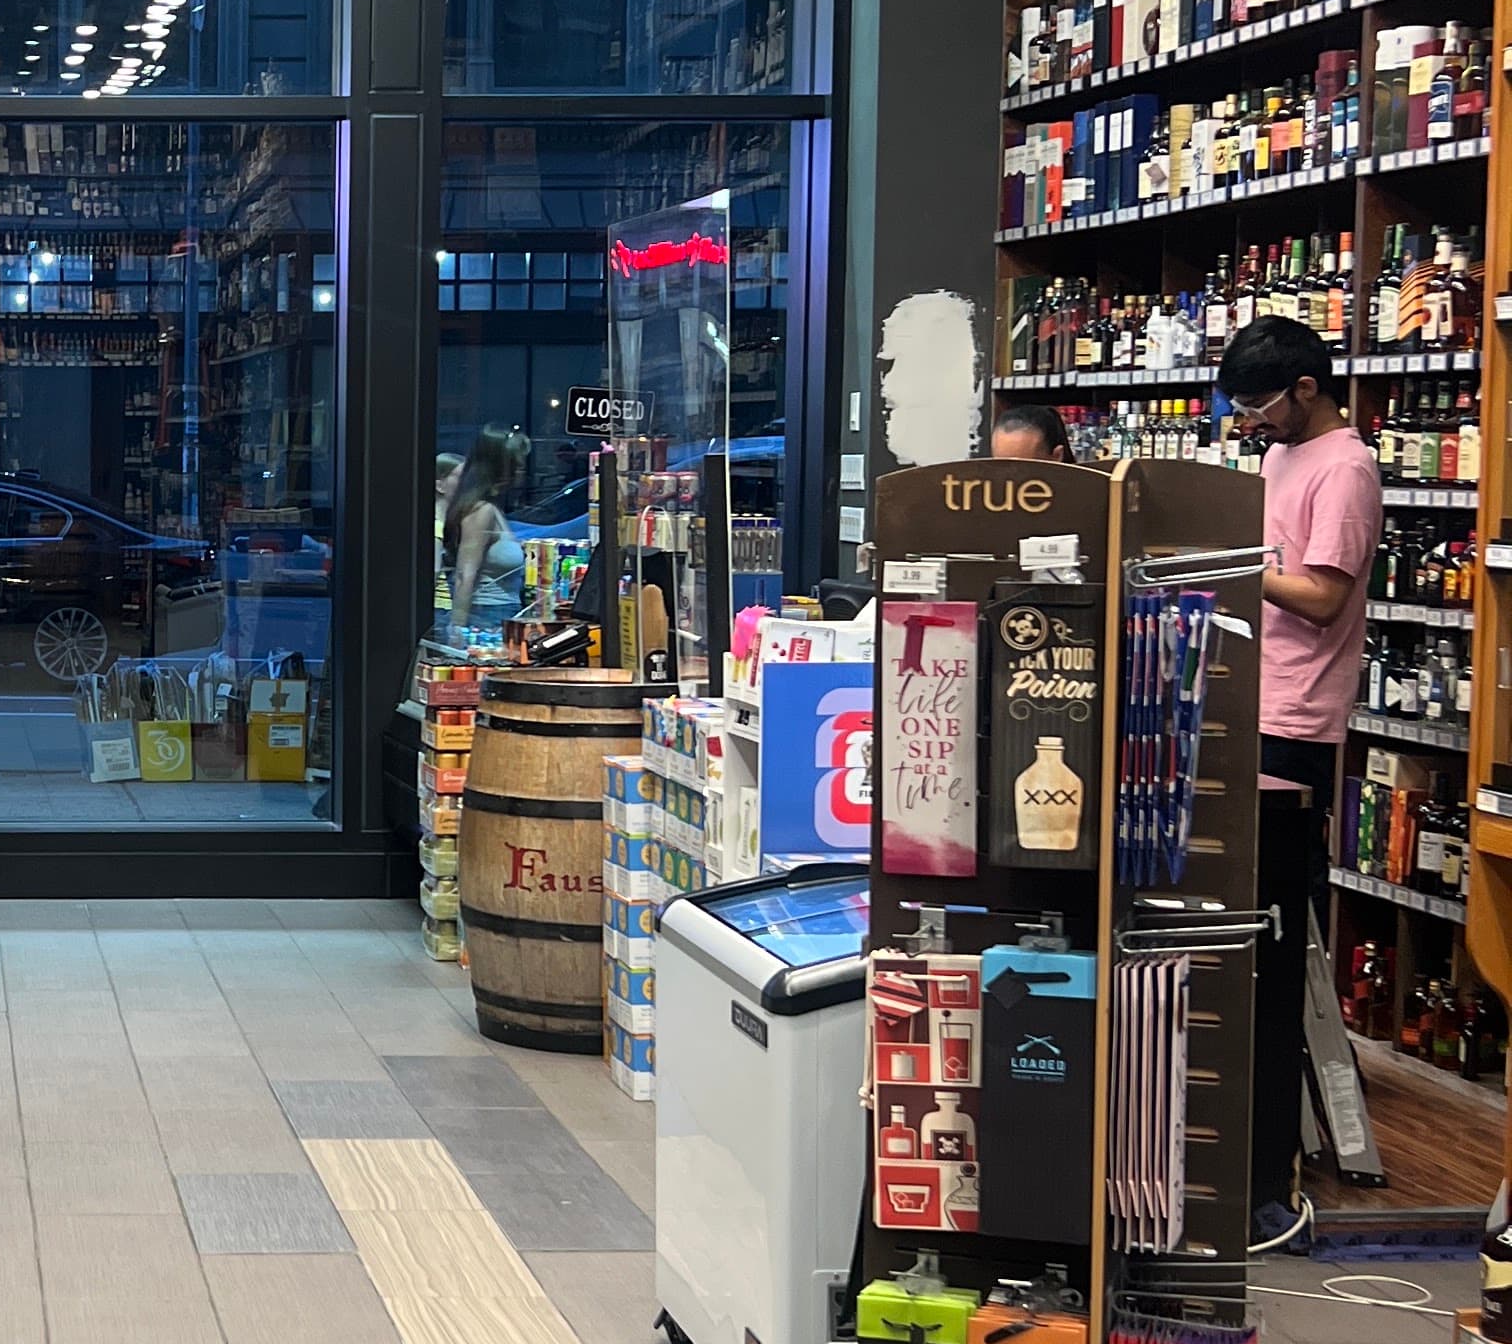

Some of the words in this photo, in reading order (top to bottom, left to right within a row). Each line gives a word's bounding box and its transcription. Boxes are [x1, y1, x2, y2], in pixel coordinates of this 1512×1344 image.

[575, 397, 645, 421] CLOSED
[941, 474, 1053, 513] true
[1052, 647, 1096, 670] YOUR
[1007, 670, 1097, 699] Poison
[901, 717, 961, 737] ONE
[908, 741, 954, 759] SIP
[937, 764, 948, 775] a
[1024, 789, 1078, 805] XXX
[1011, 1057, 1065, 1071] LOADED
